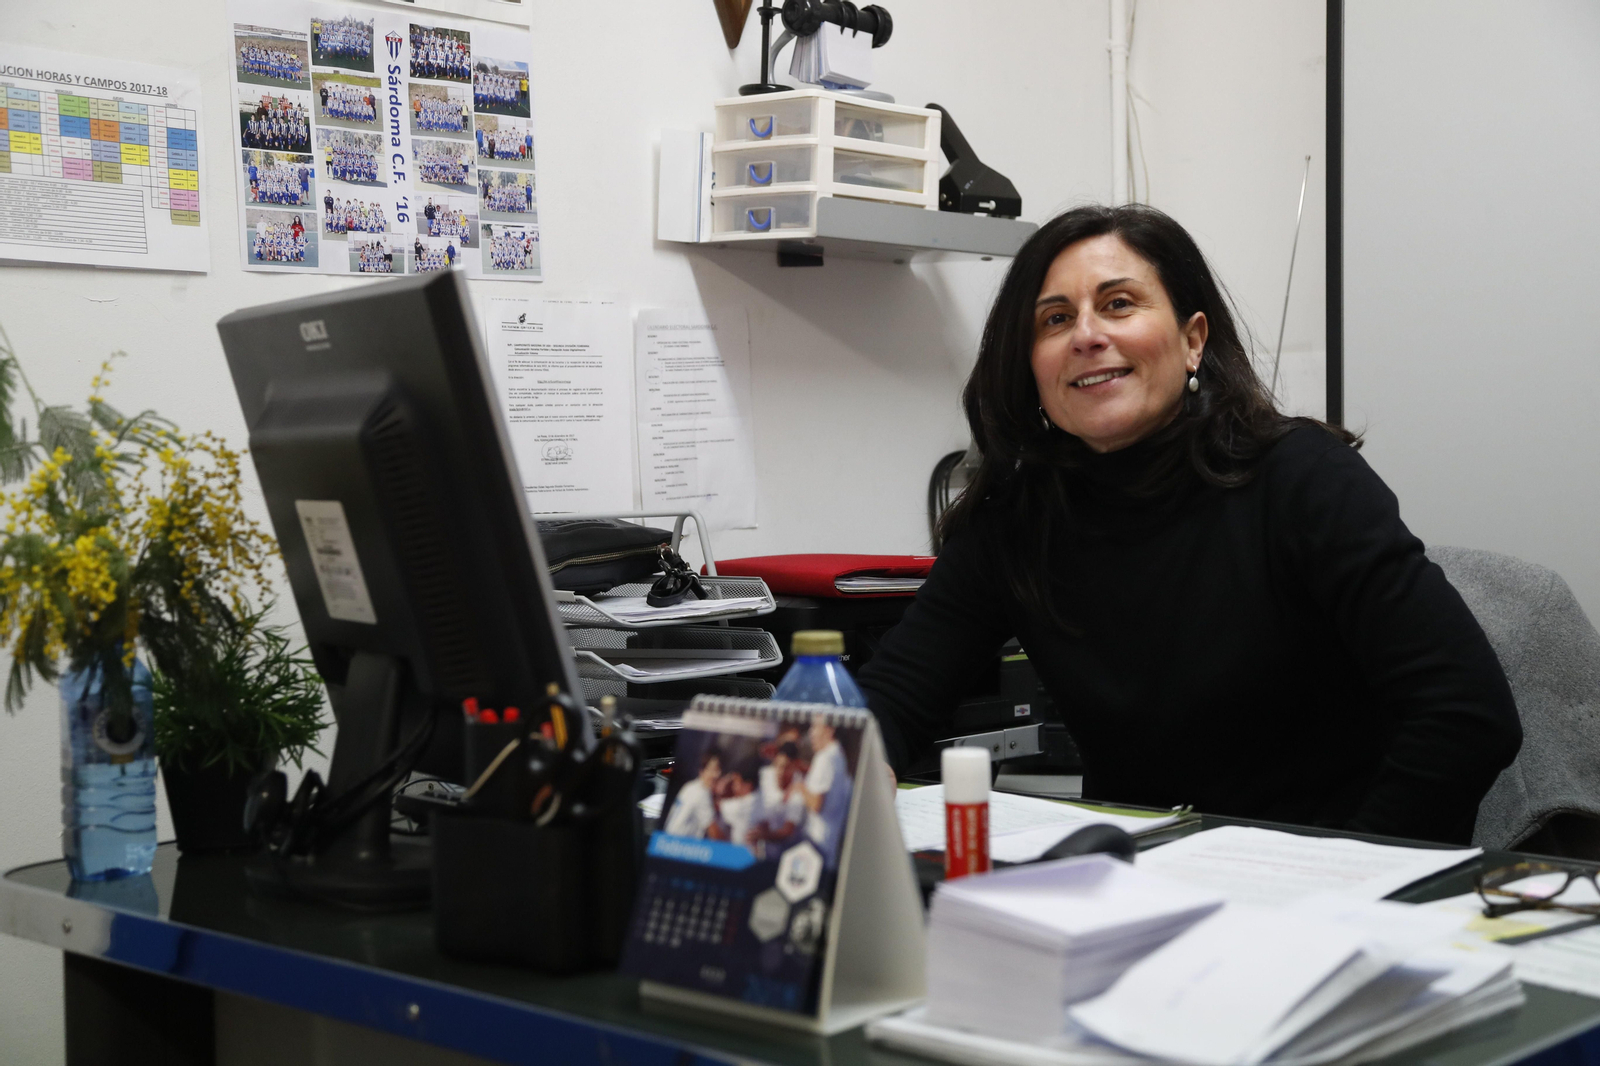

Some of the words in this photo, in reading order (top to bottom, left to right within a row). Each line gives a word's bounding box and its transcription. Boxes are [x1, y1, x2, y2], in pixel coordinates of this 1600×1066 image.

[36, 69, 72, 83] HORAS
[74, 74, 81, 84] Y
[83, 76, 127, 91] CAMPOS
[129, 82, 168, 96] 2017-18
[388, 64, 403, 147] Sárdoma
[392, 153, 406, 184] C.F.
